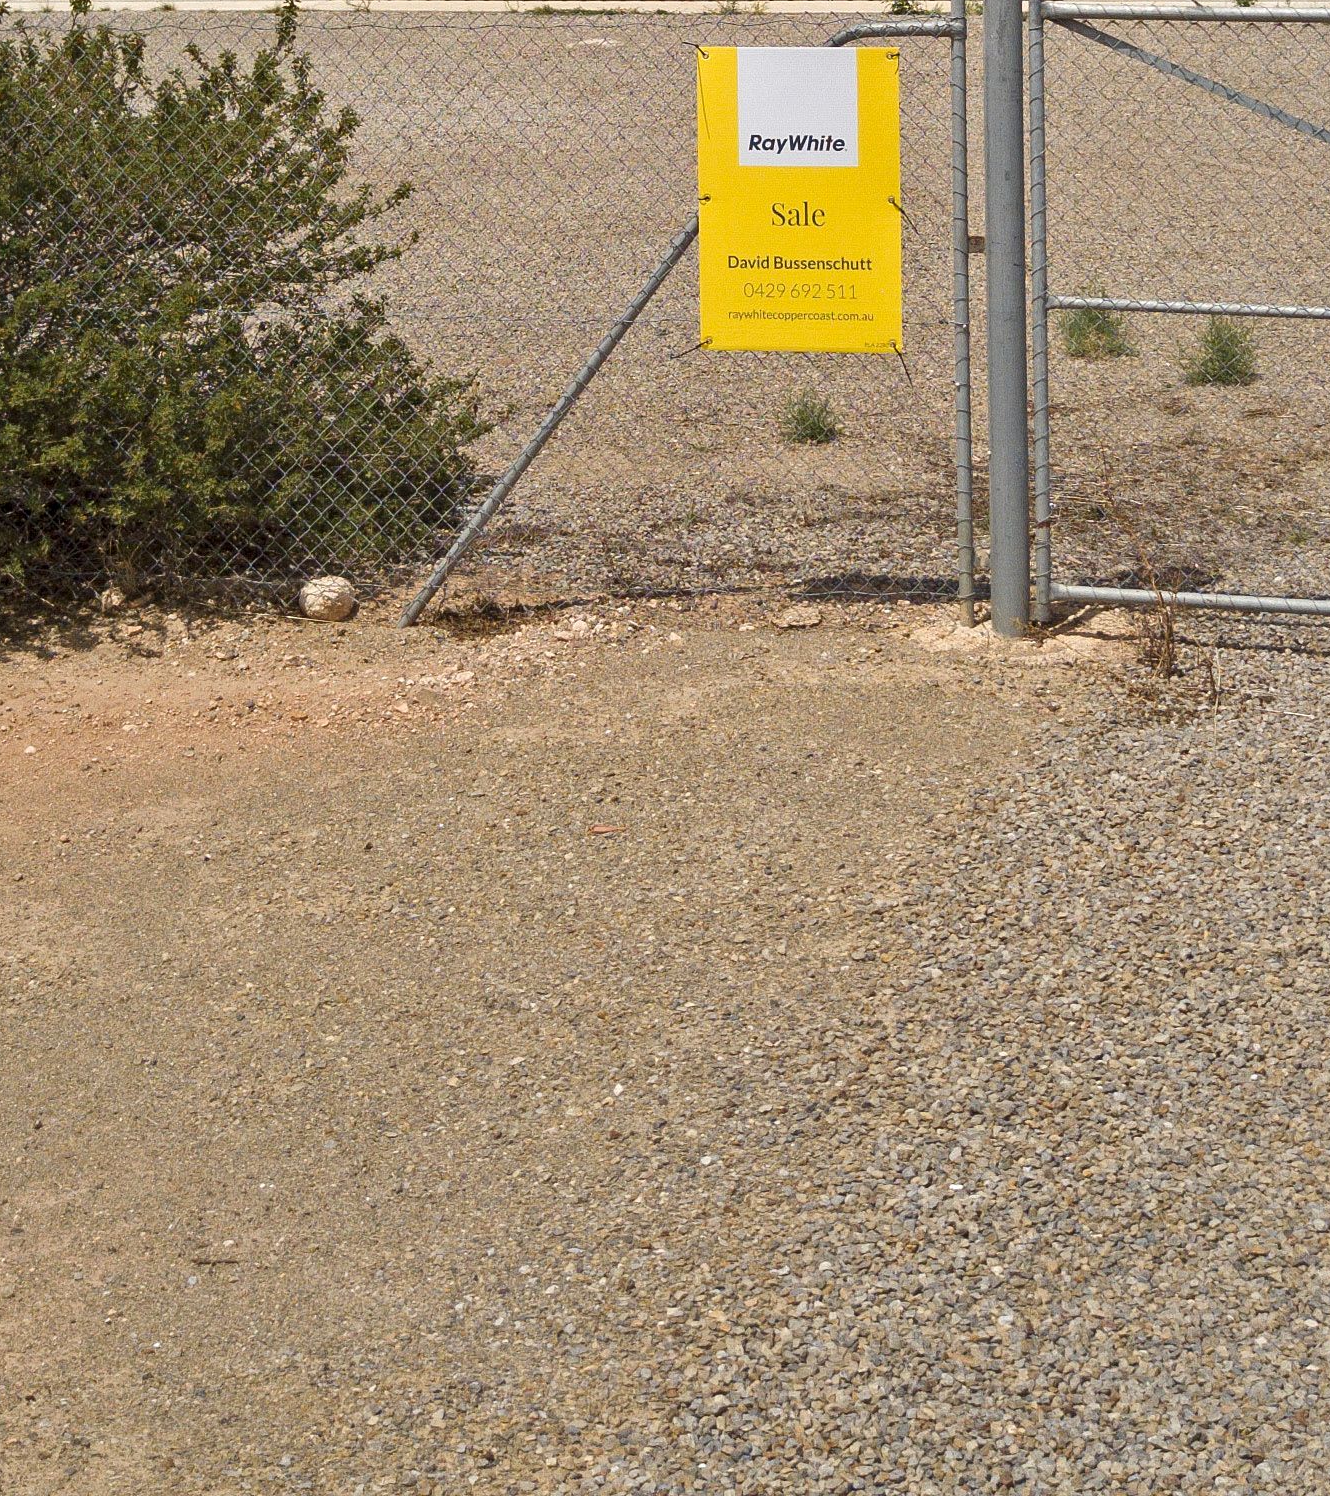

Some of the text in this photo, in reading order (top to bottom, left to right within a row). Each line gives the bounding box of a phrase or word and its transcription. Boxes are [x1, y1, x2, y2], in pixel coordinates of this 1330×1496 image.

[771, 201, 826, 227] Sale
[727, 255, 873, 271] David Bussenschutt
[743, 282, 858, 300] 0429 692 511
[727, 309, 874, 322] raywhitecoppercoast.com.au
